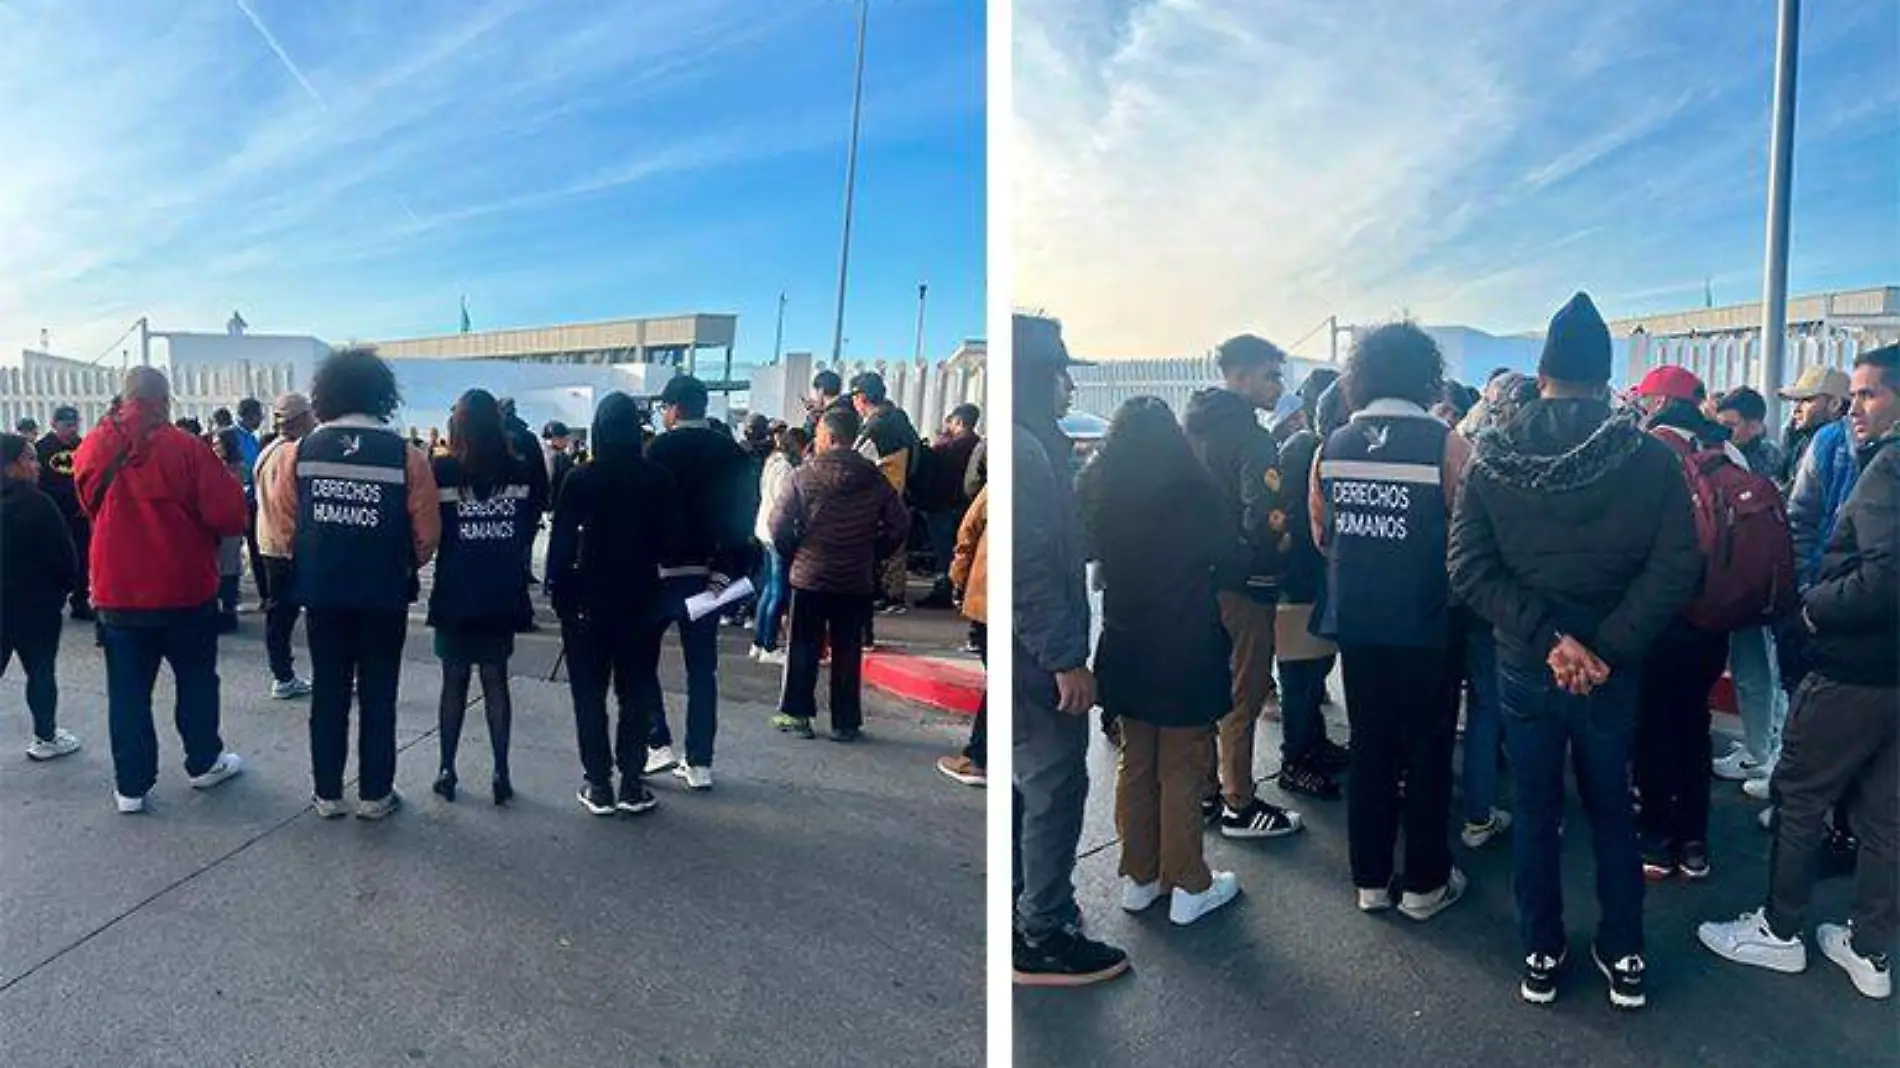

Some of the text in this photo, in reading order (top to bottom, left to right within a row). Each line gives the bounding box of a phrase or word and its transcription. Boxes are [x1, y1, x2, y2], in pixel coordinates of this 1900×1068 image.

[311, 479, 381, 503] DERECHOS
[1333, 481, 1410, 509] DERECHOS
[313, 503, 379, 527] HUMANOS
[457, 499, 516, 517] DERECHOS
[458, 521, 515, 540] HUMANOS
[1335, 512, 1408, 540] HUMANOS
